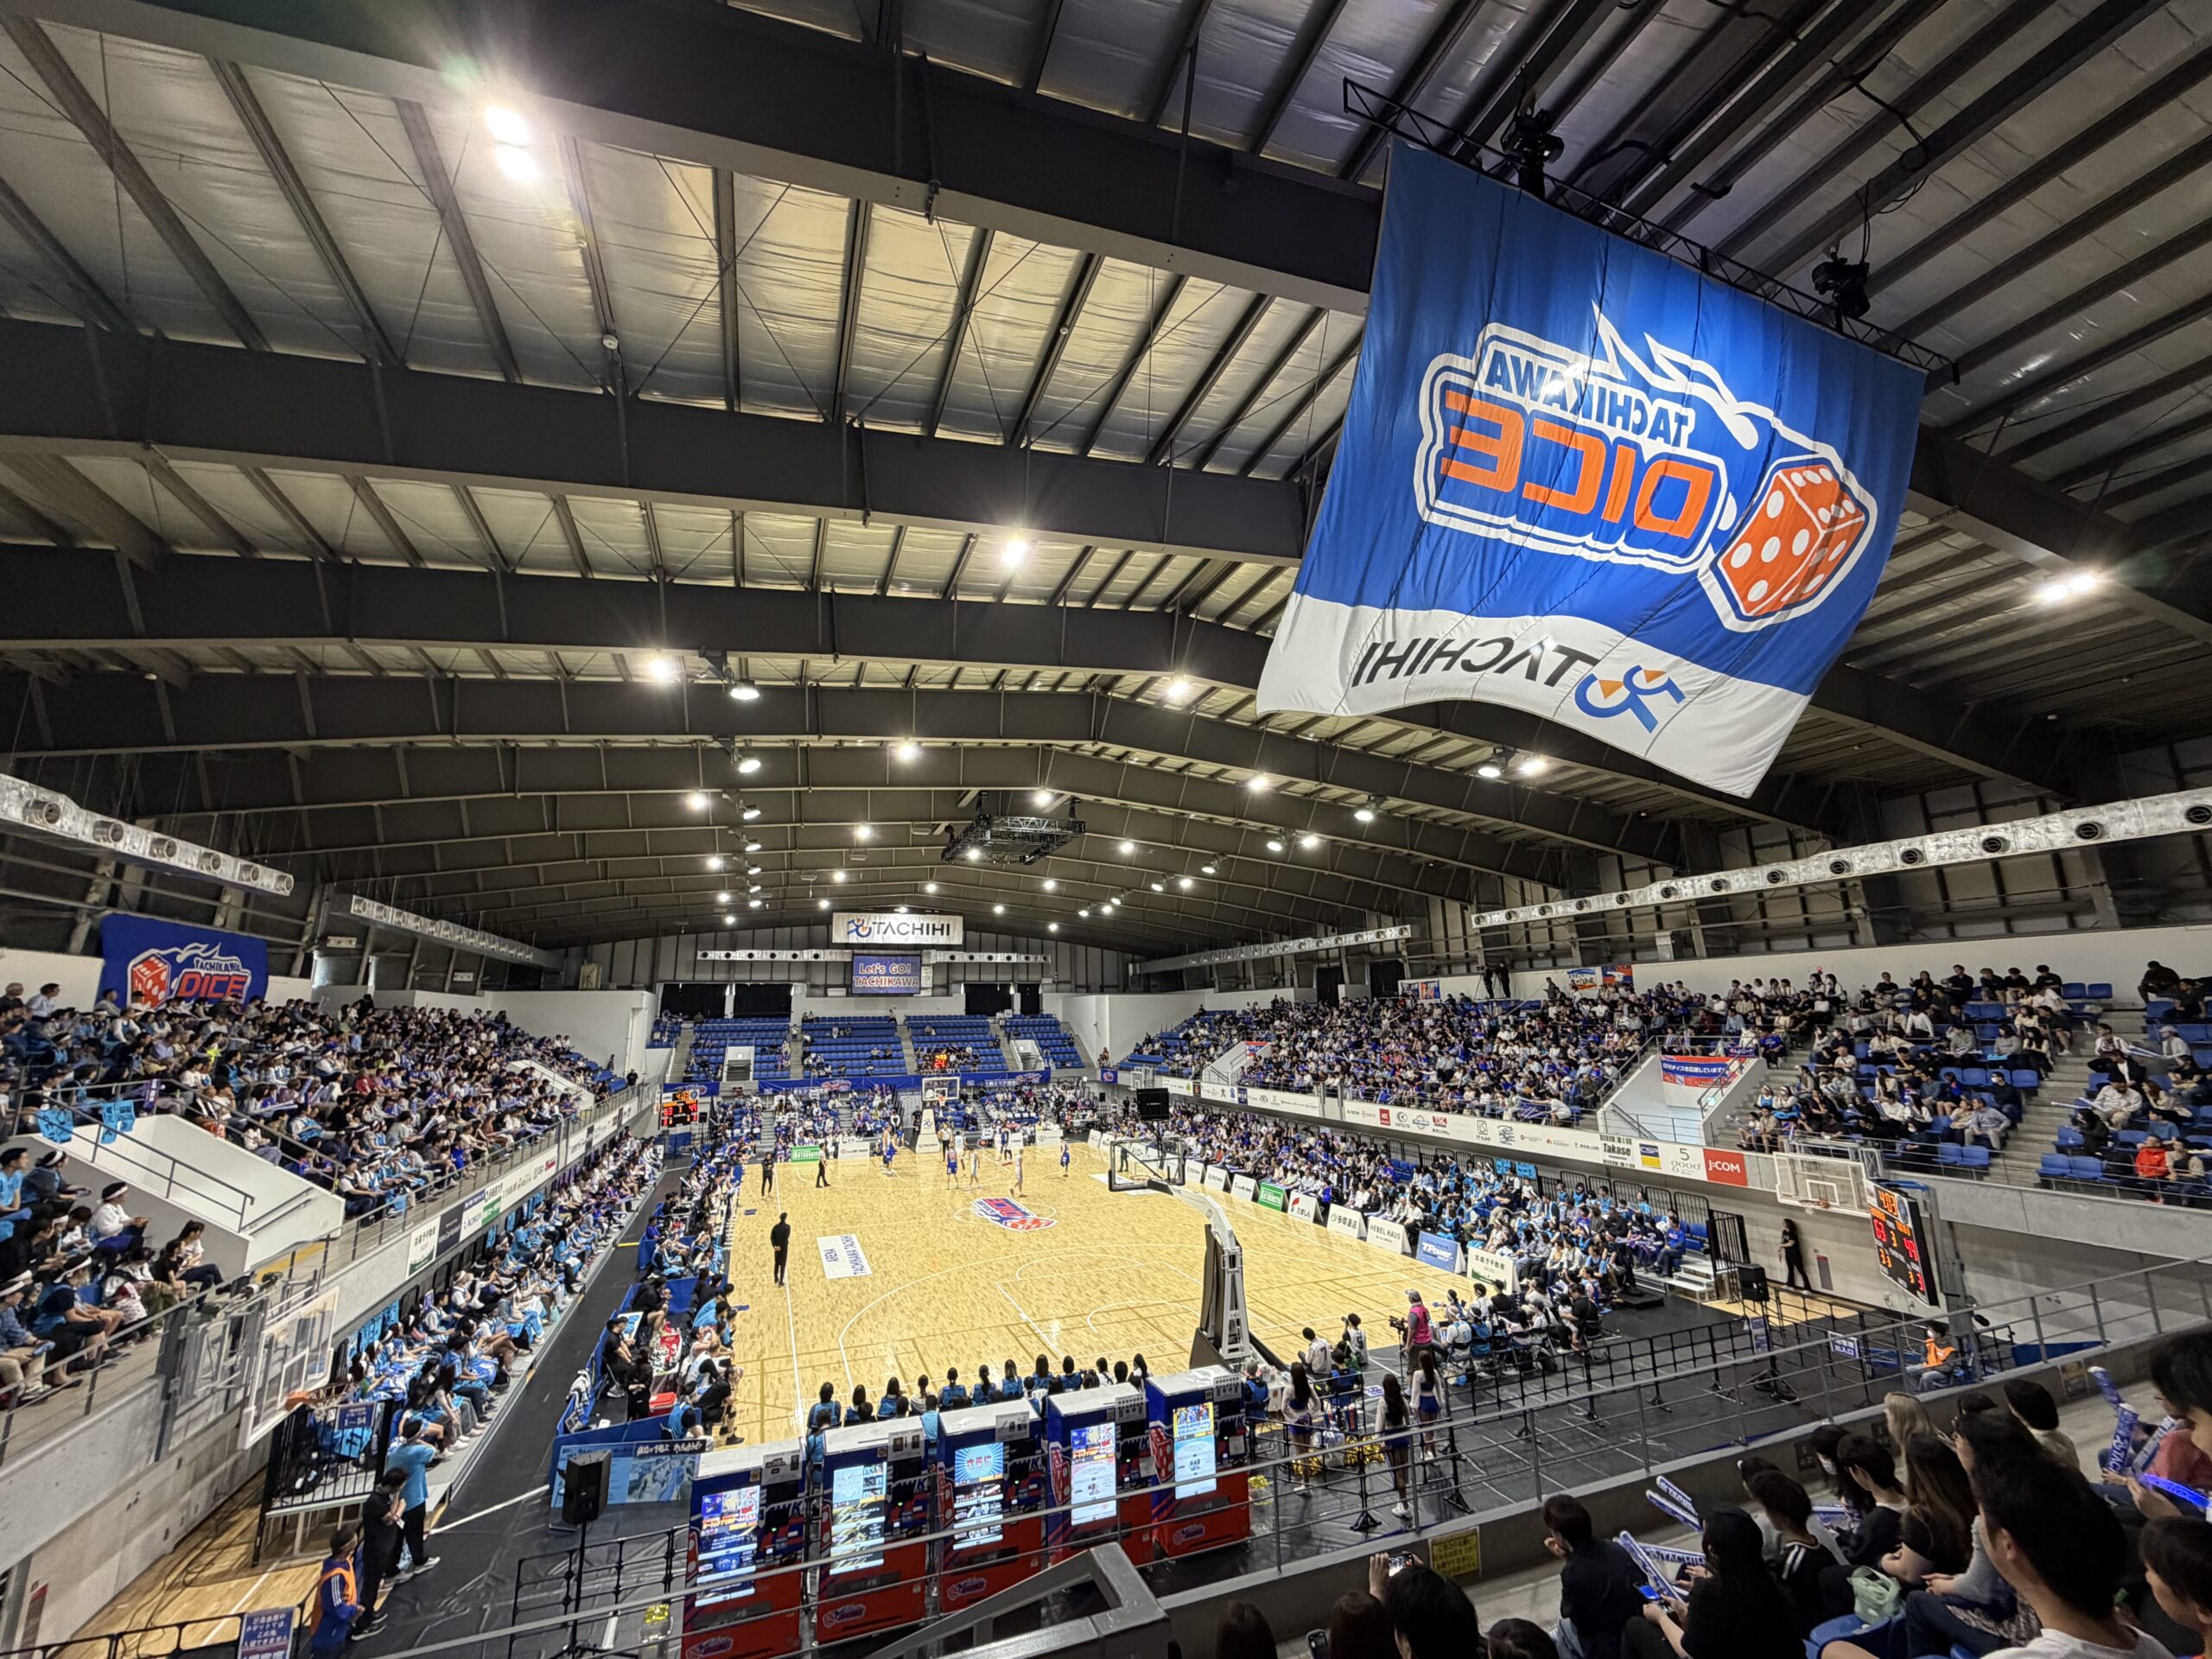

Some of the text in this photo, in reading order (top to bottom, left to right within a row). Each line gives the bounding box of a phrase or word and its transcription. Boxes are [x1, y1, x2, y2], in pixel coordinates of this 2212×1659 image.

[872, 921, 950, 937] TACHIHI
[194, 959, 242, 972] TACHIKAWA
[859, 963, 912, 975] Let's GO!
[176, 971, 249, 999] DICE
[854, 976, 920, 988] TACHIKAWA
[1603, 1142, 1631, 1157] Takase
[1679, 1147, 1690, 1161] 5
[1707, 1160, 1741, 1173] J:COM
[1370, 1224, 1387, 1236] HEBEL
[1386, 1229, 1402, 1241] HAUS
[1873, 1218, 1887, 1243] 63
[1834, 1344, 1855, 1357] 出入口
[966, 1454, 993, 1471] さらに
